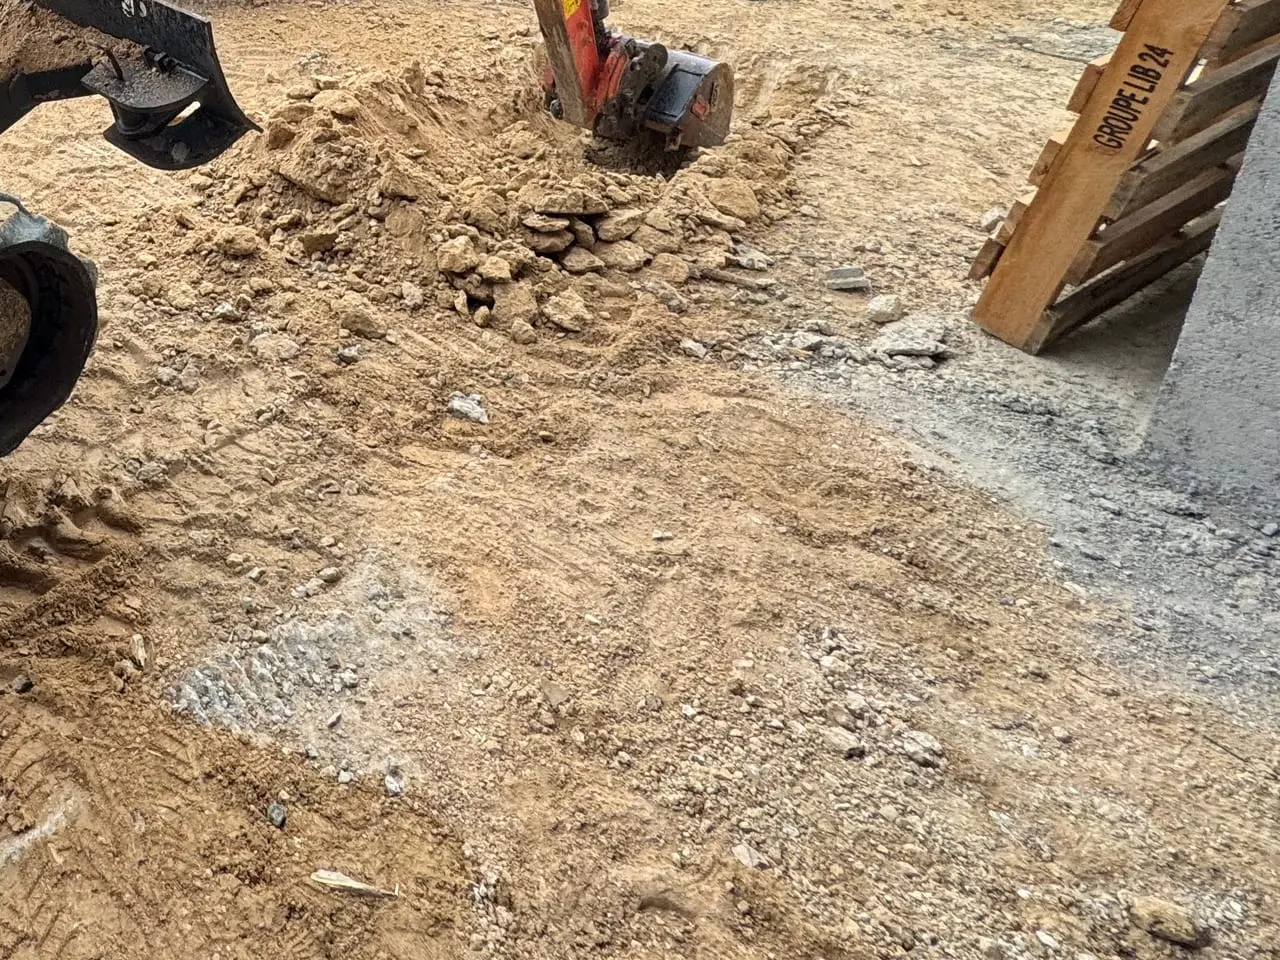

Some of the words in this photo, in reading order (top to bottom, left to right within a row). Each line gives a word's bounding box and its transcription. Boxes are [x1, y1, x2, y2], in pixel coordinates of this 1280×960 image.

[1137, 43, 1175, 68] 24
[1123, 64, 1162, 93] LIB
[1093, 88, 1150, 149] GROUPE
